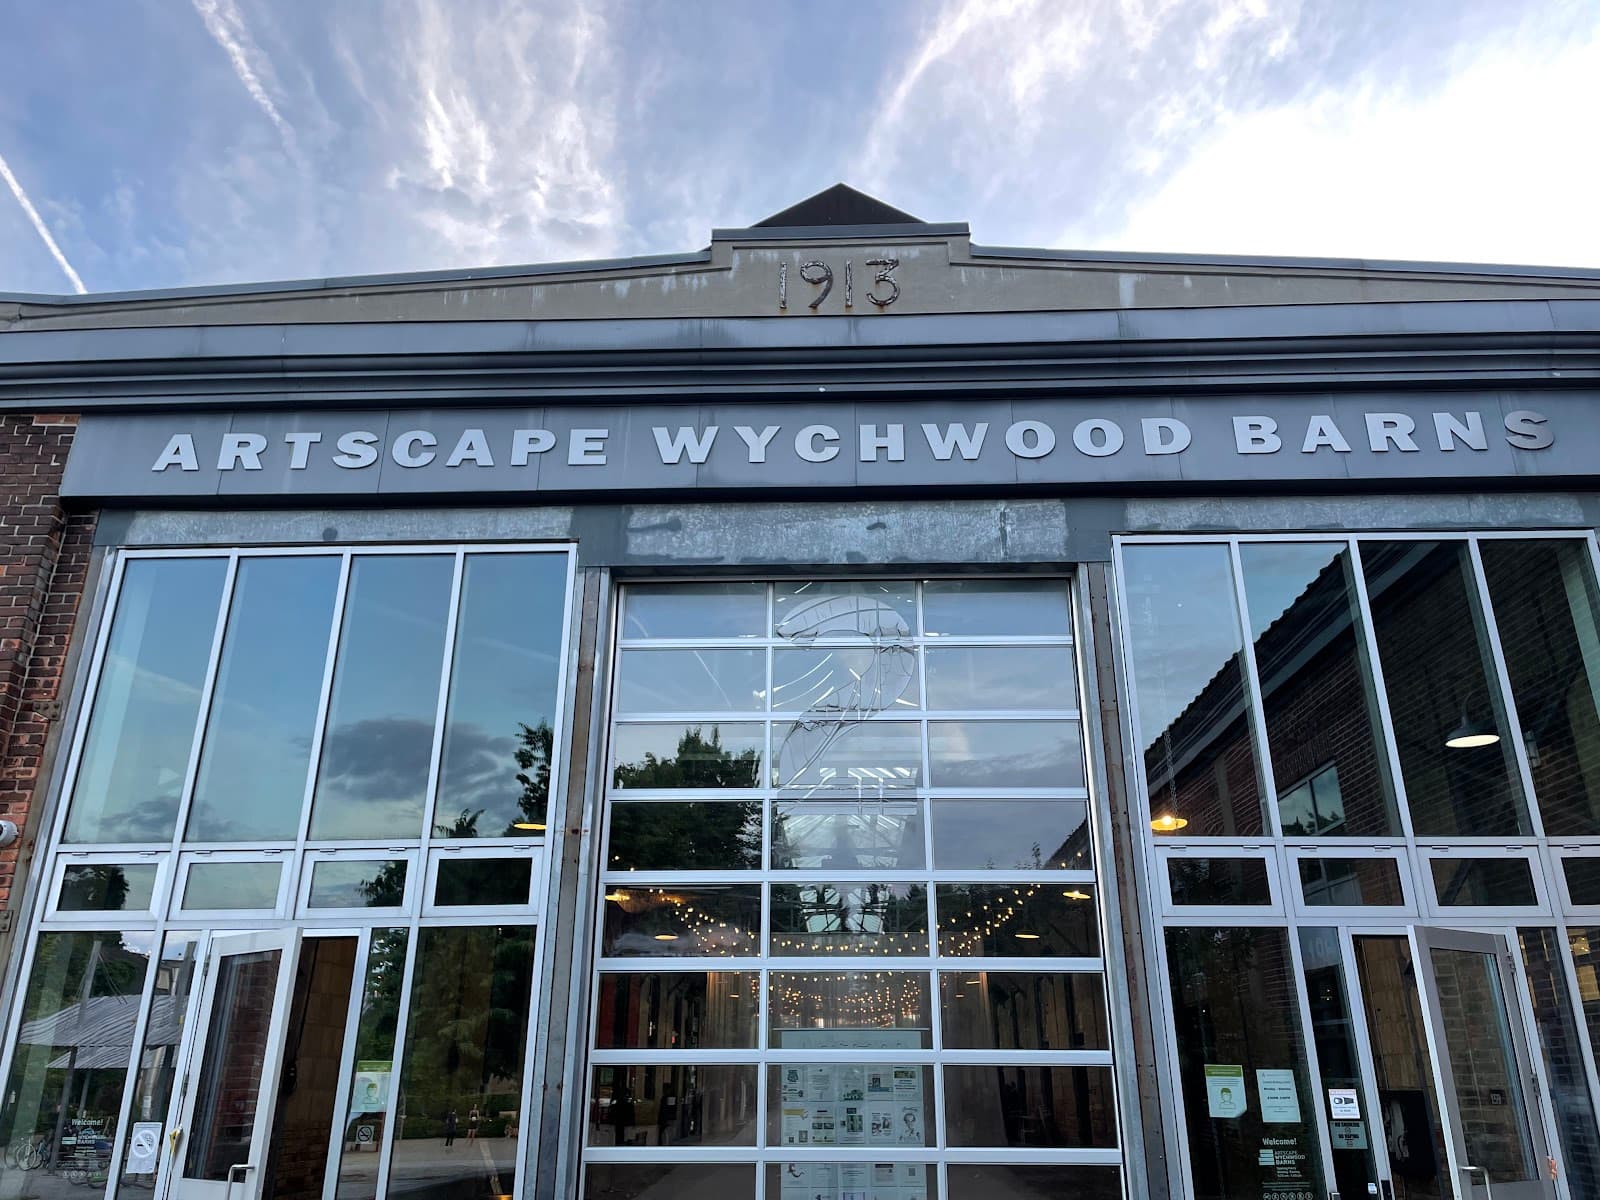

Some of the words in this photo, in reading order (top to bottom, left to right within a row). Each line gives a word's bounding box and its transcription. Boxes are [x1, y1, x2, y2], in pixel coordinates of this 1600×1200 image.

[779, 258, 900, 309] 1913
[151, 428, 610, 472] ARTSCAPE
[652, 417, 1193, 464] WYCHWOOD
[1232, 410, 1555, 454] BARNS
[1262, 1137, 1297, 1146] Welcome!
